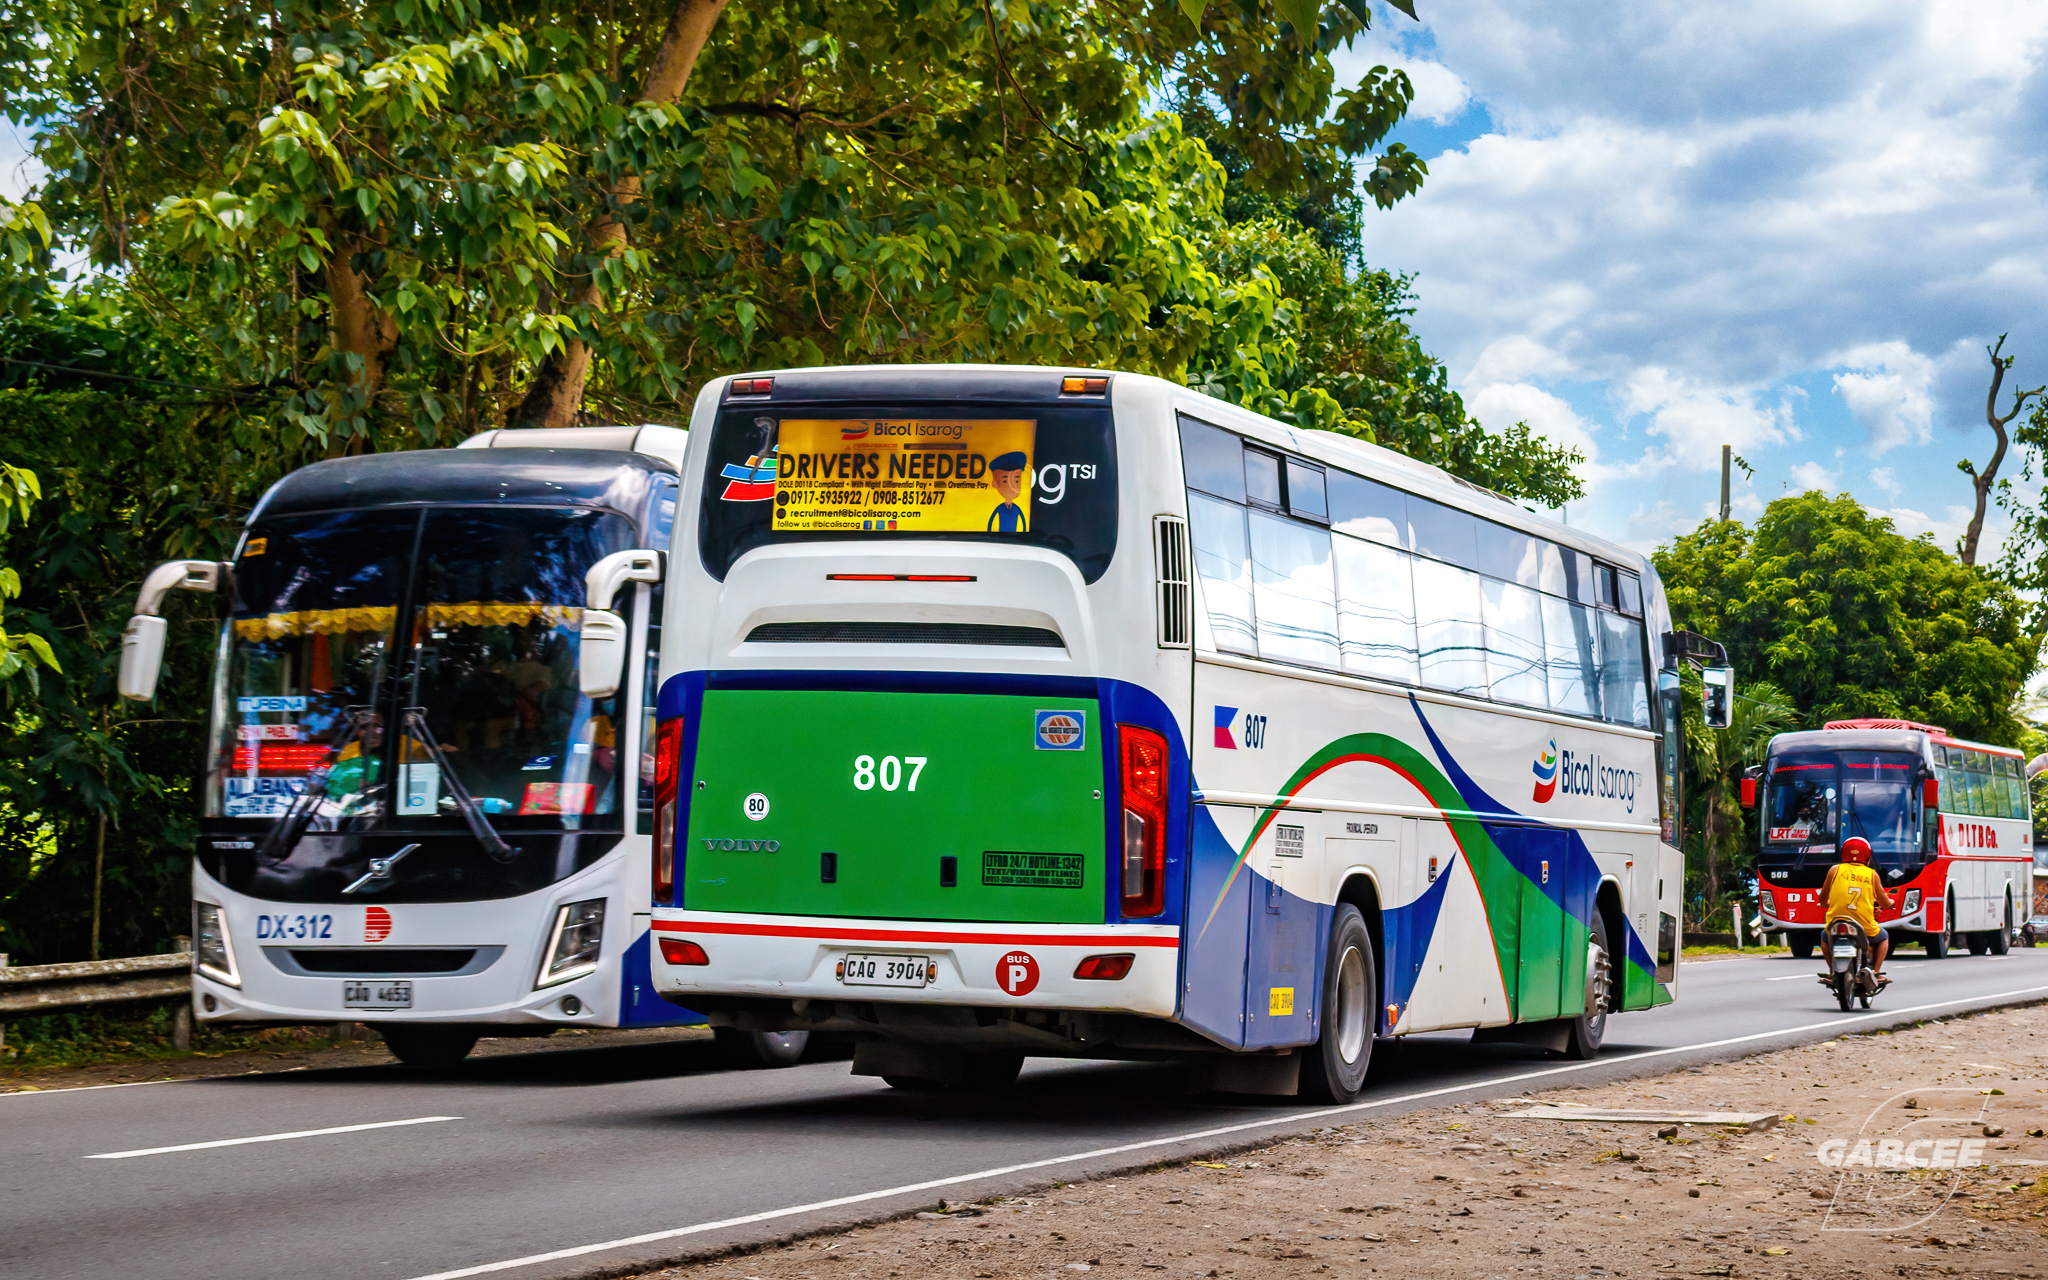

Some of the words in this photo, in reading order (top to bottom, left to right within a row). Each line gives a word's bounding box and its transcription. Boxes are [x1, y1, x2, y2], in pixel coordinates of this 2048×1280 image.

[874, 423, 911, 436] Bicol
[915, 423, 963, 440] Isarog
[779, 453, 880, 479] DRIVERS
[889, 453, 987, 479] NEEDED
[1069, 463, 1097, 480] TSI
[814, 481, 845, 490] Compliant
[865, 481, 881, 490] Night
[882, 481, 915, 489] Differential
[916, 481, 928, 490] Pay
[948, 481, 975, 489] Overtime
[977, 482, 989, 491] Pay
[790, 490, 862, 505] 0917-5935922
[872, 490, 946, 505] 0908-8512677
[790, 509, 921, 519] recruitment@bicolisarog.com
[812, 521, 861, 530] @bicolisarog
[1244, 713, 1267, 750] 807
[853, 755, 927, 792] 807
[1561, 749, 1594, 797] Bicol
[1597, 755, 1635, 814] Isarog
[748, 798, 765, 812] 80
[1770, 827, 1791, 839] LRT
[701, 838, 780, 853] VOLVO
[1009, 855, 1027, 868] 24/7
[1038, 869, 1080, 878] HOTLINES
[1847, 886, 1861, 911] 7
[1788, 911, 1796, 920] P
[256, 914, 333, 939] DX-312
[1006, 955, 1030, 964] BUS
[847, 960, 876, 979] CAQ
[886, 961, 924, 980] 3904
[1008, 964, 1027, 992] P
